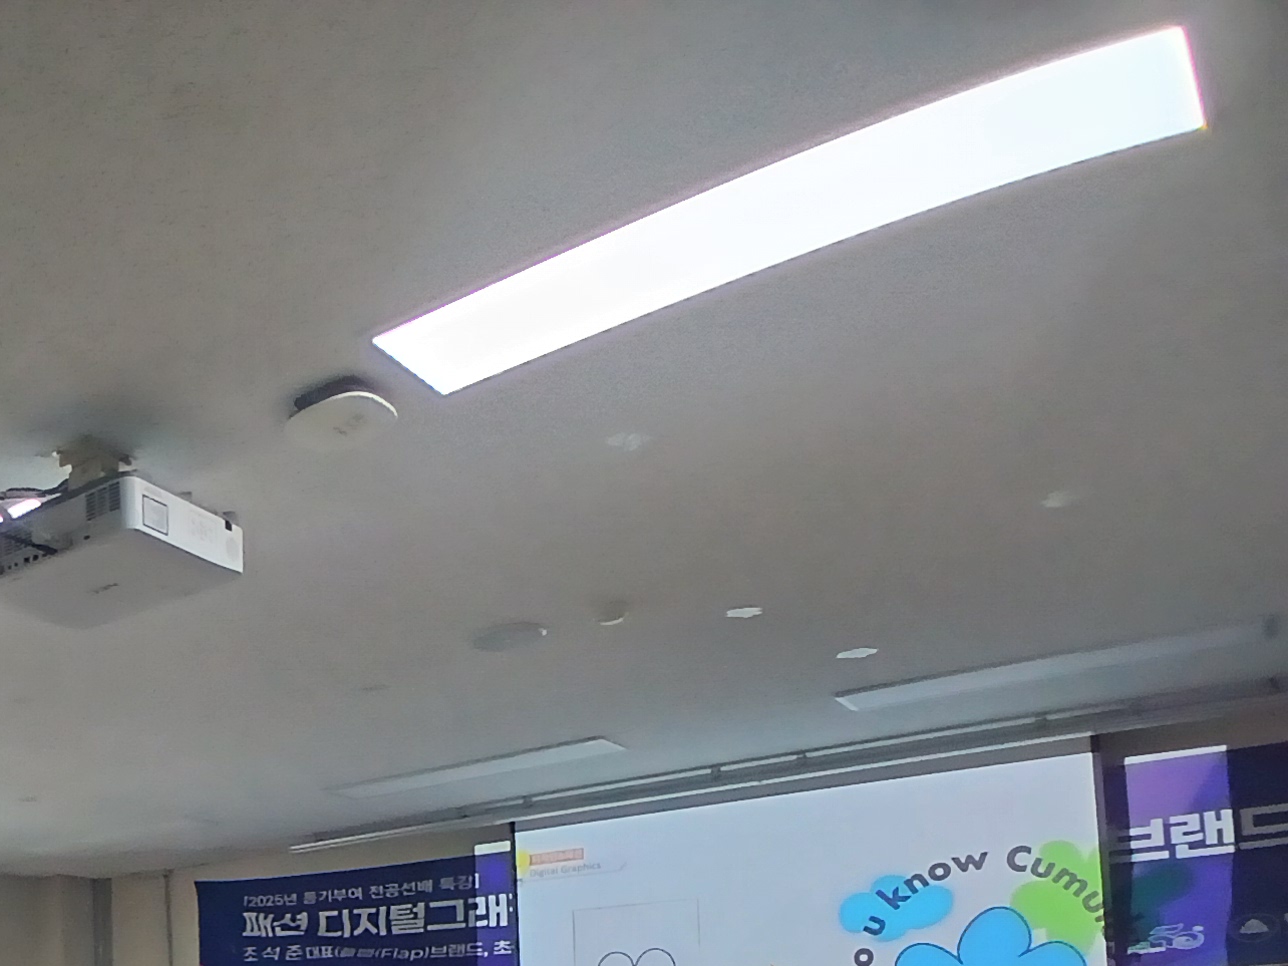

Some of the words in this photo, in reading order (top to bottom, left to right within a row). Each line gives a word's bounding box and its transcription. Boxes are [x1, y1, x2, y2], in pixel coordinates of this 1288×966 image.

[530, 867, 559, 877] Digital
[561, 862, 602, 874] Graphics
[874, 851, 989, 911] know
[242, 911, 309, 938] 패션
[862, 915, 887, 937] u
